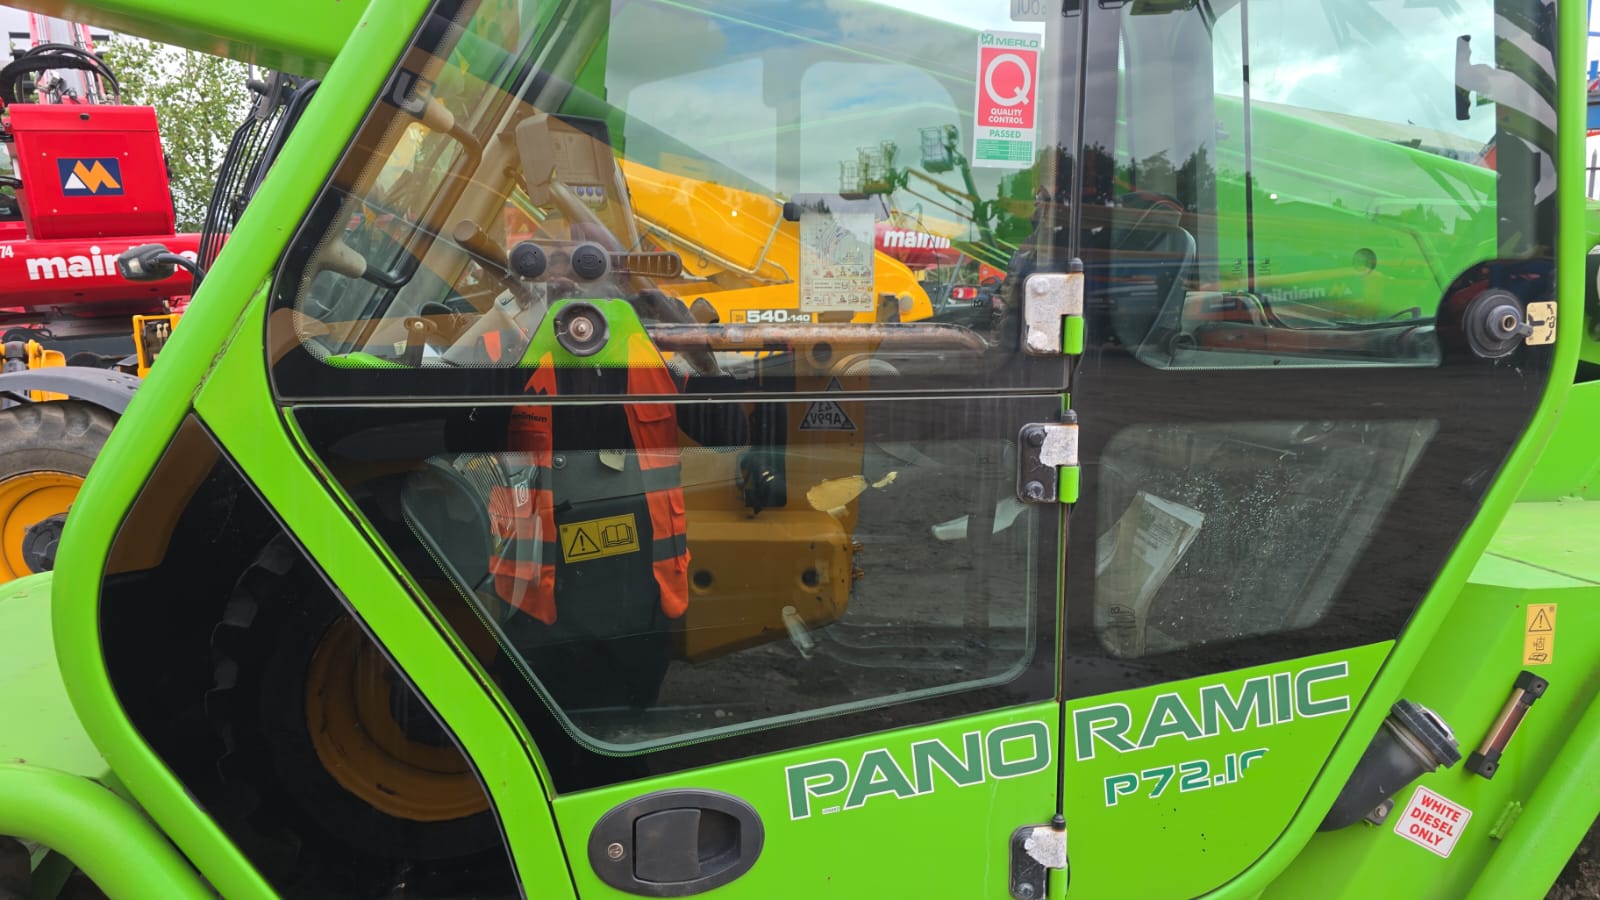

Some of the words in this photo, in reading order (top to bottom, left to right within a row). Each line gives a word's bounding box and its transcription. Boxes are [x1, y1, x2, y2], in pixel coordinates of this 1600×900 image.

[996, 38, 1038, 48] MERLO
[985, 53, 1031, 107] Q
[988, 116, 1024, 125] CONTROL
[991, 108, 1022, 117] QUALITY
[989, 129, 1021, 138] PASSED
[1421, 794, 1462, 823] WHITE
[1411, 806, 1453, 837] DIESEL
[1410, 823, 1444, 846] ONLY
